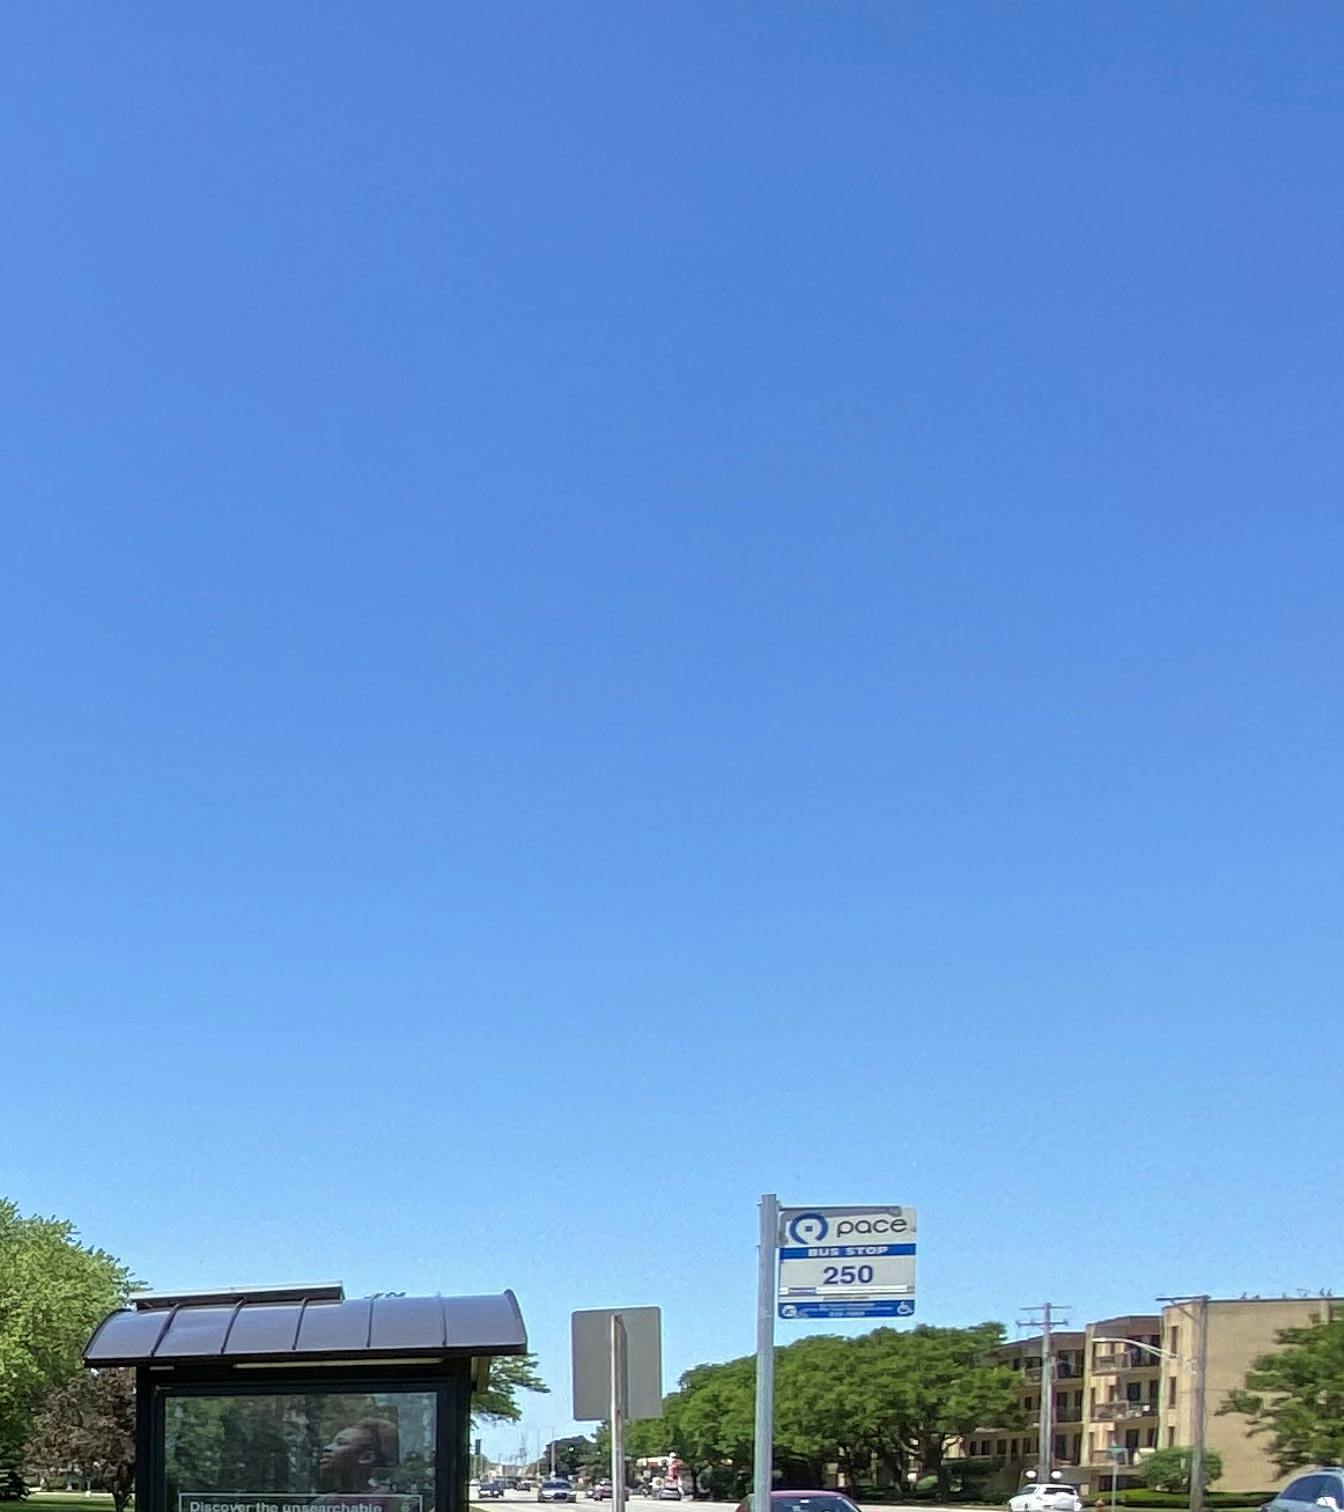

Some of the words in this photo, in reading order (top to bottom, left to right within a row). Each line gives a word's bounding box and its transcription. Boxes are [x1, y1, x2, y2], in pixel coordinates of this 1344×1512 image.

[837, 1218, 908, 1238] pace
[807, 1247, 839, 1257] BUS
[846, 1246, 889, 1256] STOP
[823, 1265, 873, 1285] 250
